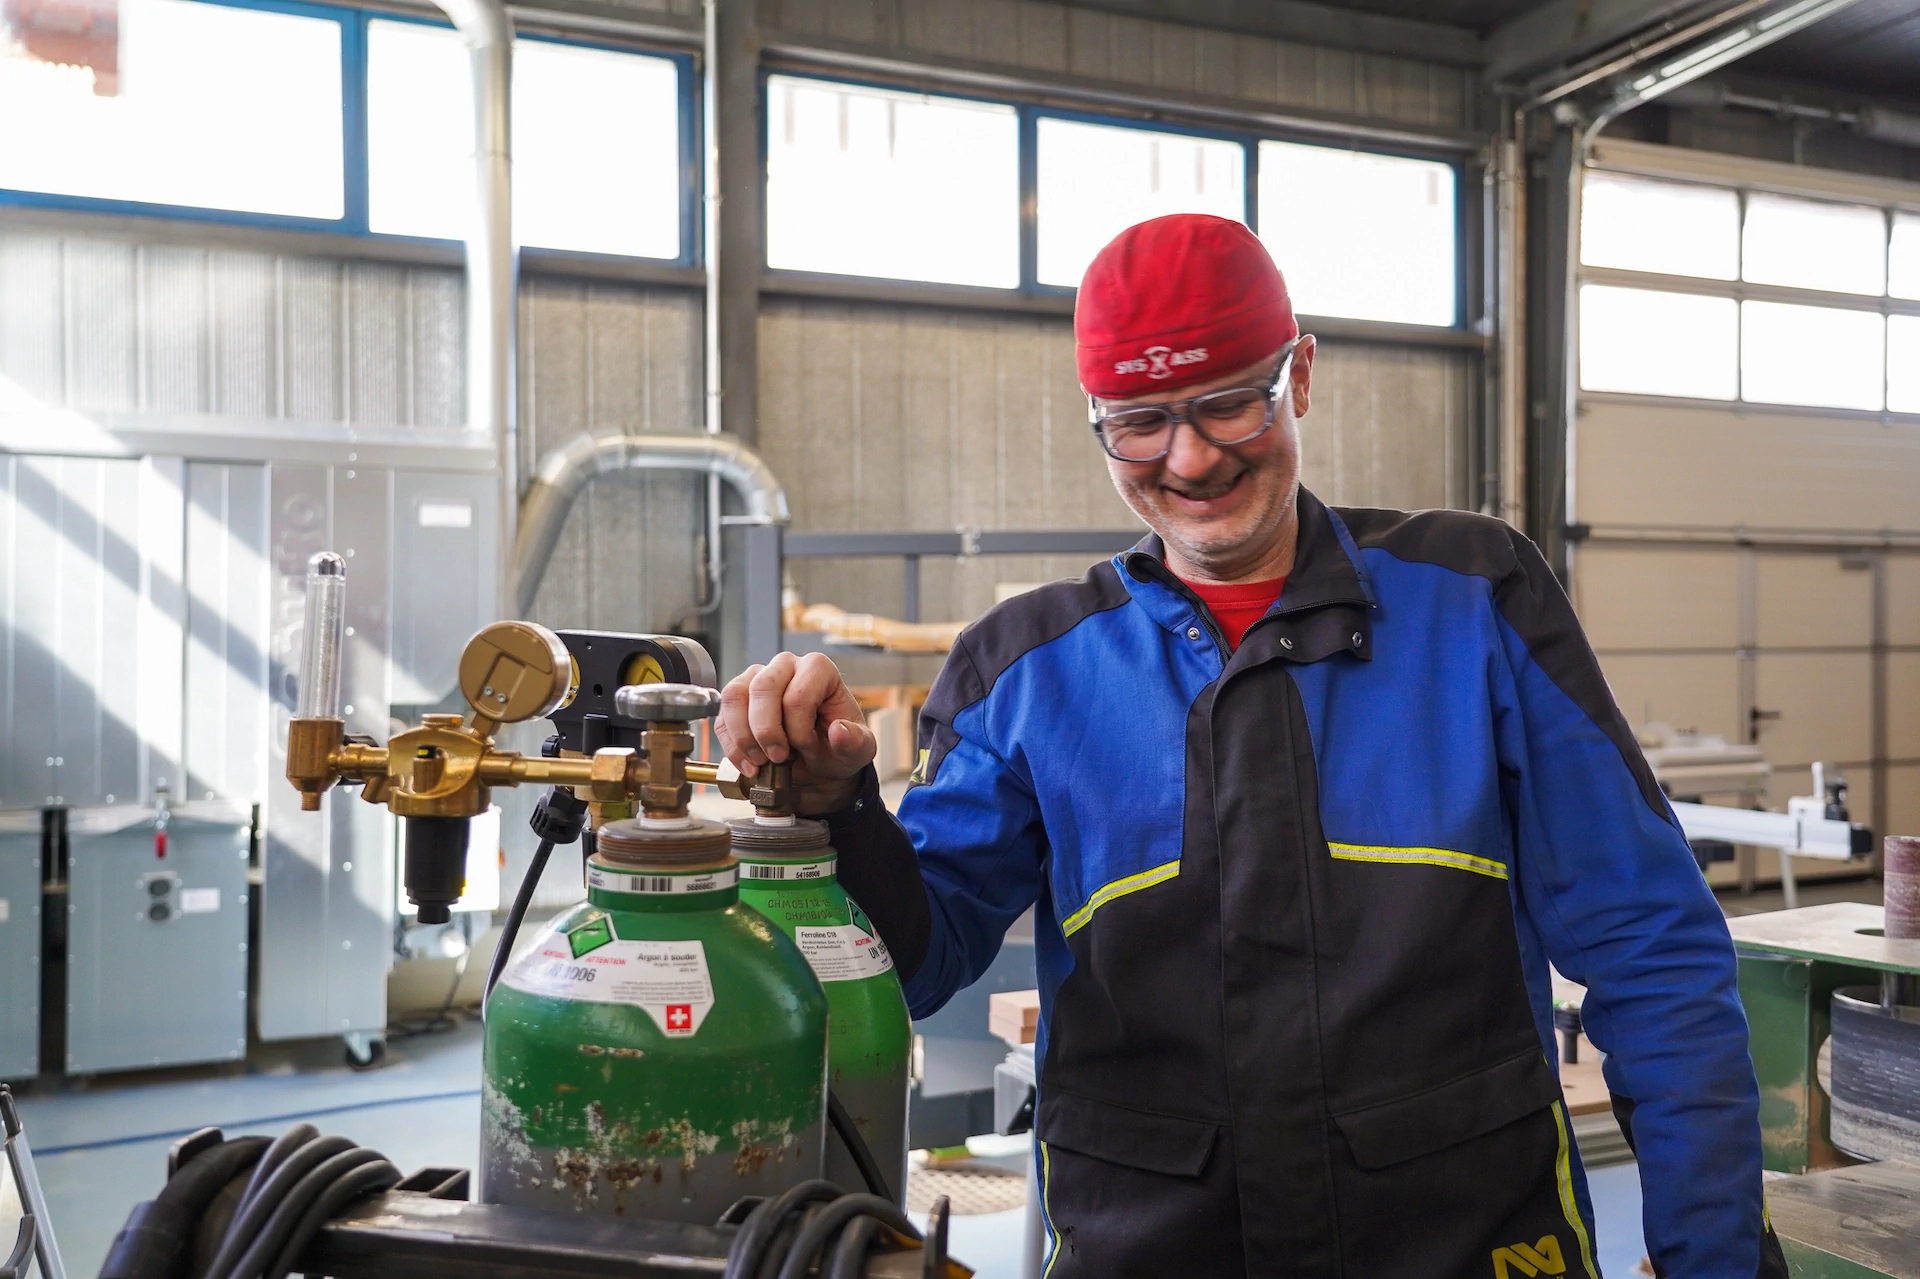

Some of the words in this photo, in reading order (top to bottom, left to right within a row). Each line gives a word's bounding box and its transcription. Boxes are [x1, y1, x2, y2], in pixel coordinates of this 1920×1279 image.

[801, 931, 827, 939] Ferroline
[637, 953, 662, 964] Argon
[671, 952, 697, 961] souder
[868, 946, 880, 959] UN
[585, 955, 626, 966] ATTENTION
